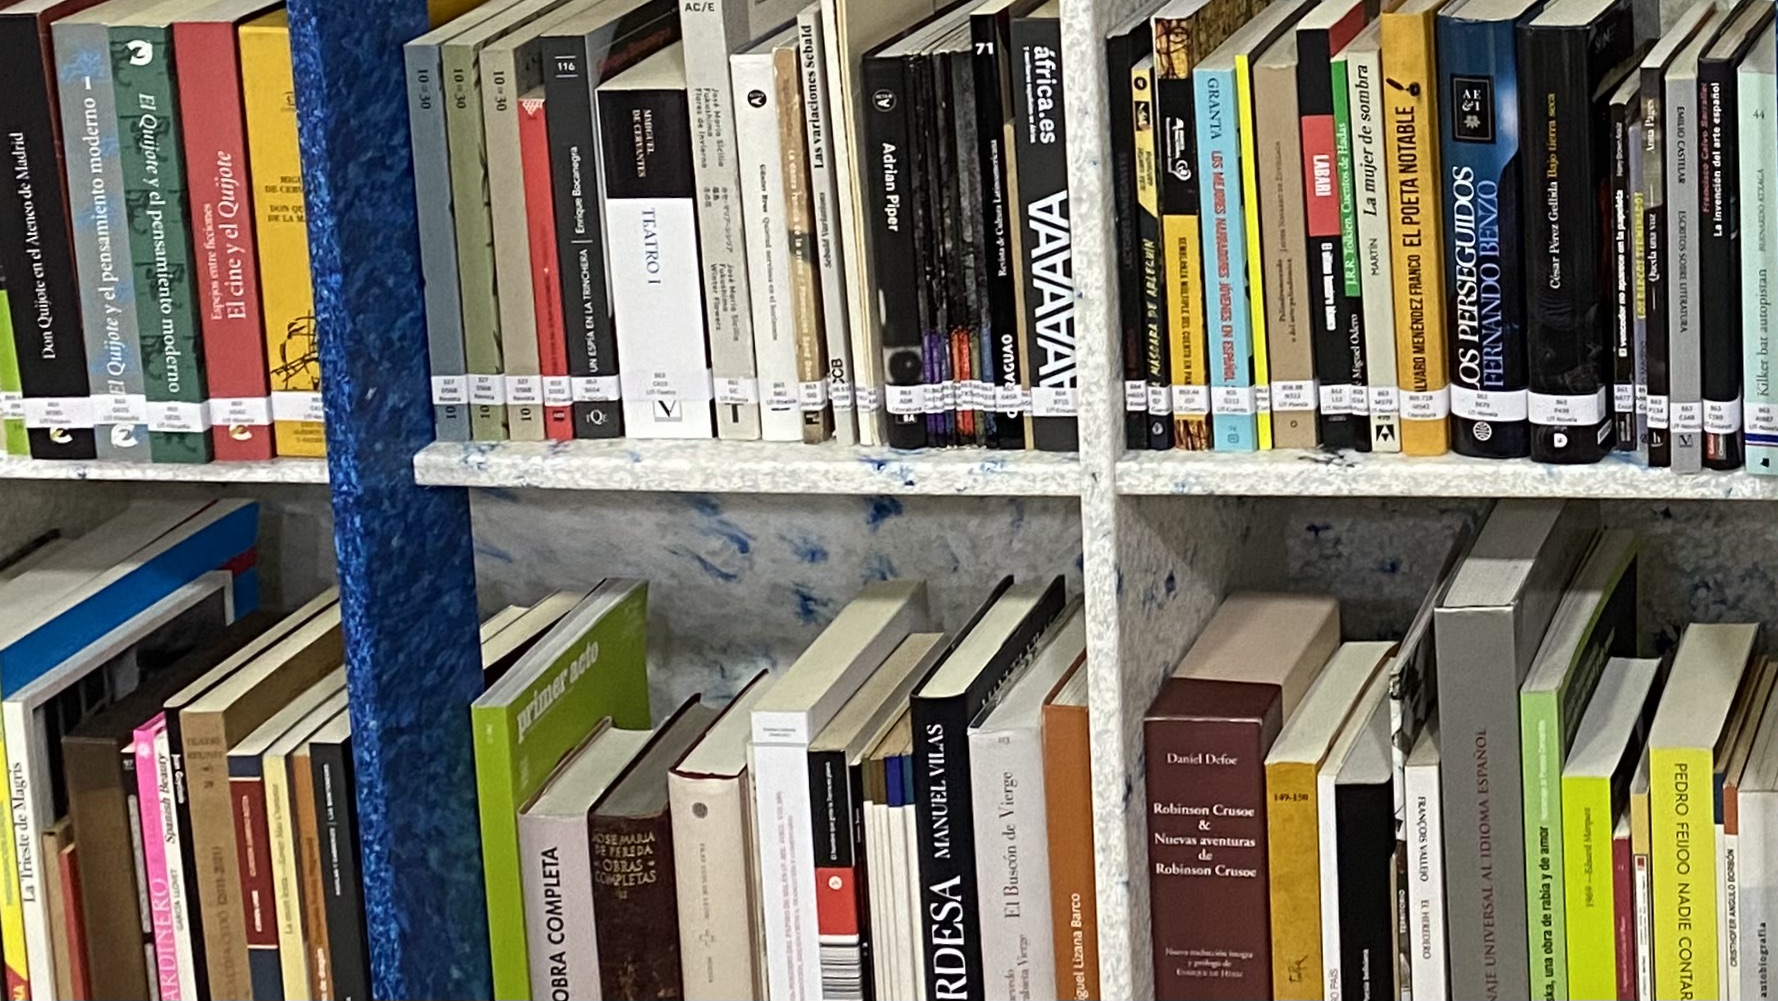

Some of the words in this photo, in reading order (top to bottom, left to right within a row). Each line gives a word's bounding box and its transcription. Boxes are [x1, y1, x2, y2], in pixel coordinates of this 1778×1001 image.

[800, 24, 817, 68] Sebald
[805, 71, 823, 144] variaciones
[1206, 77, 1223, 140] GRANTA
[1354, 65, 1374, 124] sombra
[10, 132, 31, 180] Madrid
[81, 97, 102, 173] moderno
[809, 146, 824, 169] Las
[1358, 128, 1375, 144] de
[1394, 106, 1418, 173] NOTABLE
[18, 183, 33, 197] de
[215, 151, 237, 219] Quijote
[881, 143, 898, 191] Adrian
[1360, 148, 1380, 195] mujer
[22, 200, 39, 246] Ateneo
[885, 195, 900, 232] Piper
[1362, 198, 1378, 217] La
[1399, 177, 1420, 226] POETA
[1478, 180, 1500, 257] BENZO
[88, 177, 119, 282] pensamiento
[220, 223, 238, 239] el
[227, 244, 243, 254] y
[1402, 230, 1421, 247] EL
[26, 248, 41, 260] el
[31, 262, 44, 277] en
[225, 258, 244, 296] cine
[1368, 237, 1380, 276] MARTÍN
[1407, 255, 1423, 295] FRANCO
[1452, 166, 1480, 343] PERSEGUIDOS
[33, 280, 55, 328] Quijote
[99, 285, 116, 300] el
[106, 304, 122, 314] y
[227, 300, 246, 319] El
[40, 331, 56, 359] Don
[102, 317, 127, 375] Quijote
[1407, 298, 1425, 354] MENÉNDEZ
[1480, 262, 1504, 387] FERNANDO
[108, 379, 125, 394] El
[926, 724, 946, 776] VILAS
[1472, 729, 1490, 794] ESPAÑOL
[8, 762, 27, 811] Magris
[998, 771, 1019, 819] Vierge
[1153, 803, 1210, 816] Robinson
[1212, 807, 1255, 817] Crusoe
[1675, 763, 1689, 816] PEDRO
[14, 814, 28, 831] de
[928, 779, 952, 859] MANUEL
[1002, 824, 1018, 840] de
[1477, 797, 1493, 859] IDIOMA
[16, 834, 33, 882] Trieste
[1002, 843, 1020, 896] Buscón
[1481, 863, 1493, 881] AL
[1676, 822, 1689, 875] FEIJOO
[21, 885, 36, 903] La
[541, 847, 564, 945] COMPLETA
[1003, 901, 1021, 918] El
[1069, 893, 1084, 927] Barco
[1676, 881, 1692, 930] NADIE
[1072, 930, 1086, 969] Lizana
[1479, 884, 1499, 967] UNIVERSAL
[549, 951, 570, 1001] OBRA
